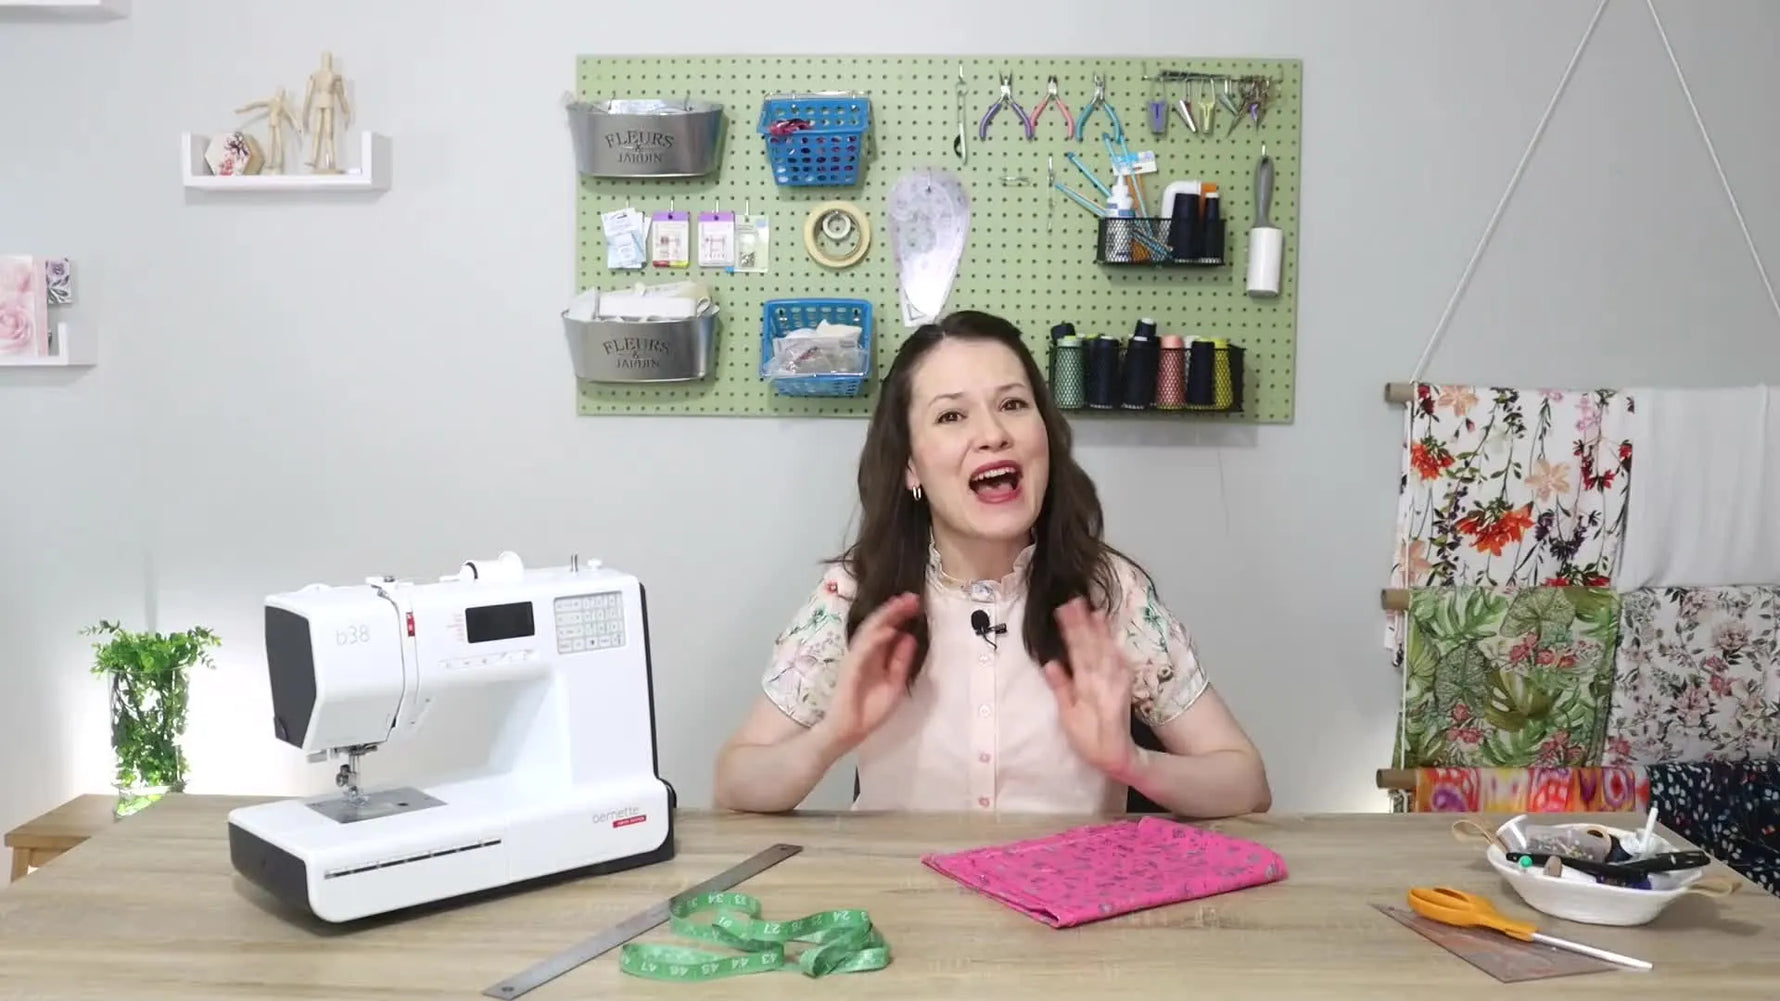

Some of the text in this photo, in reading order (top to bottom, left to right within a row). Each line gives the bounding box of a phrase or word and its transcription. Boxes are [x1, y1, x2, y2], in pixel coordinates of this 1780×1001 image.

[604, 130, 675, 149] FLEURS
[617, 152, 662, 163] JARDIN
[602, 336, 671, 355] FLEURS
[616, 359, 660, 369] JARDIN
[336, 623, 370, 646] b38
[708, 892, 725, 905] 34
[833, 910, 851, 922] 24
[763, 922, 781, 935] 27
[731, 957, 749, 970] 44
[761, 952, 776, 965] 43
[640, 960, 657, 972] 47
[669, 964, 689, 977] 46
[701, 962, 720, 976] 45
